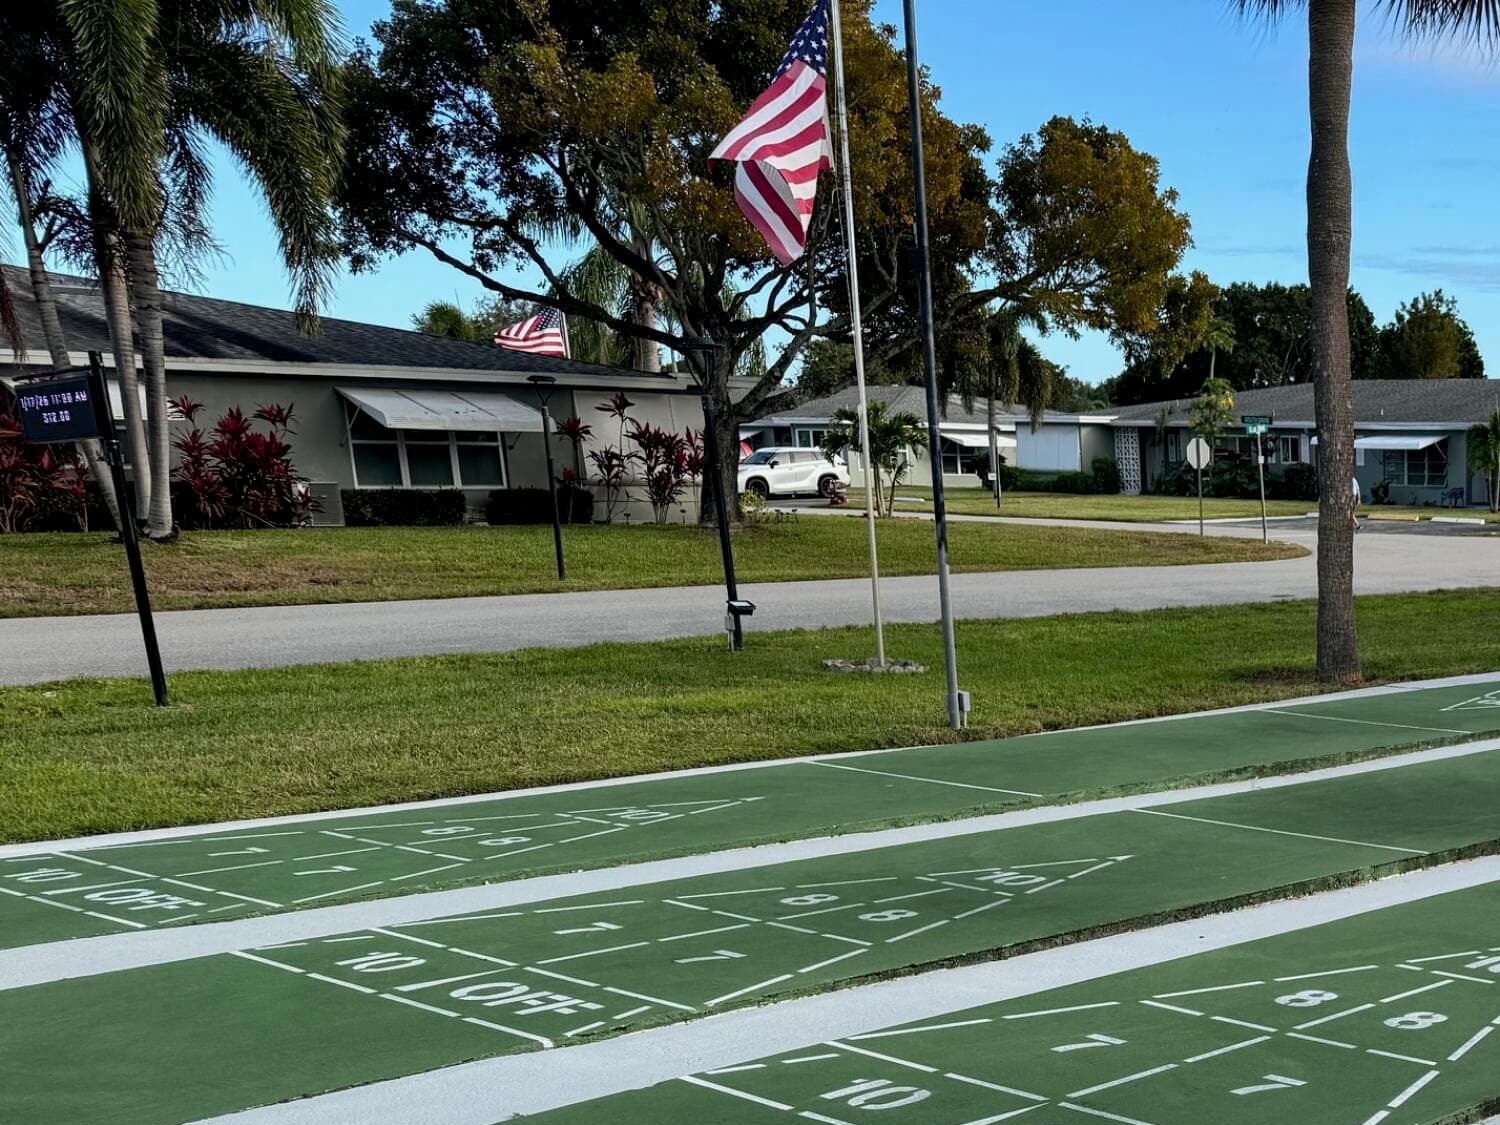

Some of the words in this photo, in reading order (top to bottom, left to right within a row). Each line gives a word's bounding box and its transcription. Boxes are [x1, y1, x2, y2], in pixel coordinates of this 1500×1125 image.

[75, 390, 88, 402] AM
[607, 810, 669, 819] 10
[478, 837, 531, 845] 8
[208, 847, 269, 856] 7
[4, 869, 82, 882] 10
[294, 866, 357, 875] 7
[976, 872, 1046, 885] 10
[84, 889, 205, 910] OFF
[781, 894, 839, 905] 8
[859, 910, 918, 921] 8
[554, 922, 622, 934] 7
[335, 952, 426, 972] 10
[675, 950, 747, 963] 7
[450, 982, 604, 1015] OFF
[1275, 990, 1338, 1006] 8
[1384, 1009, 1450, 1031] 8
[1051, 1034, 1127, 1052] 7
[1230, 1074, 1307, 1095] 7
[820, 1079, 931, 1109] 10
